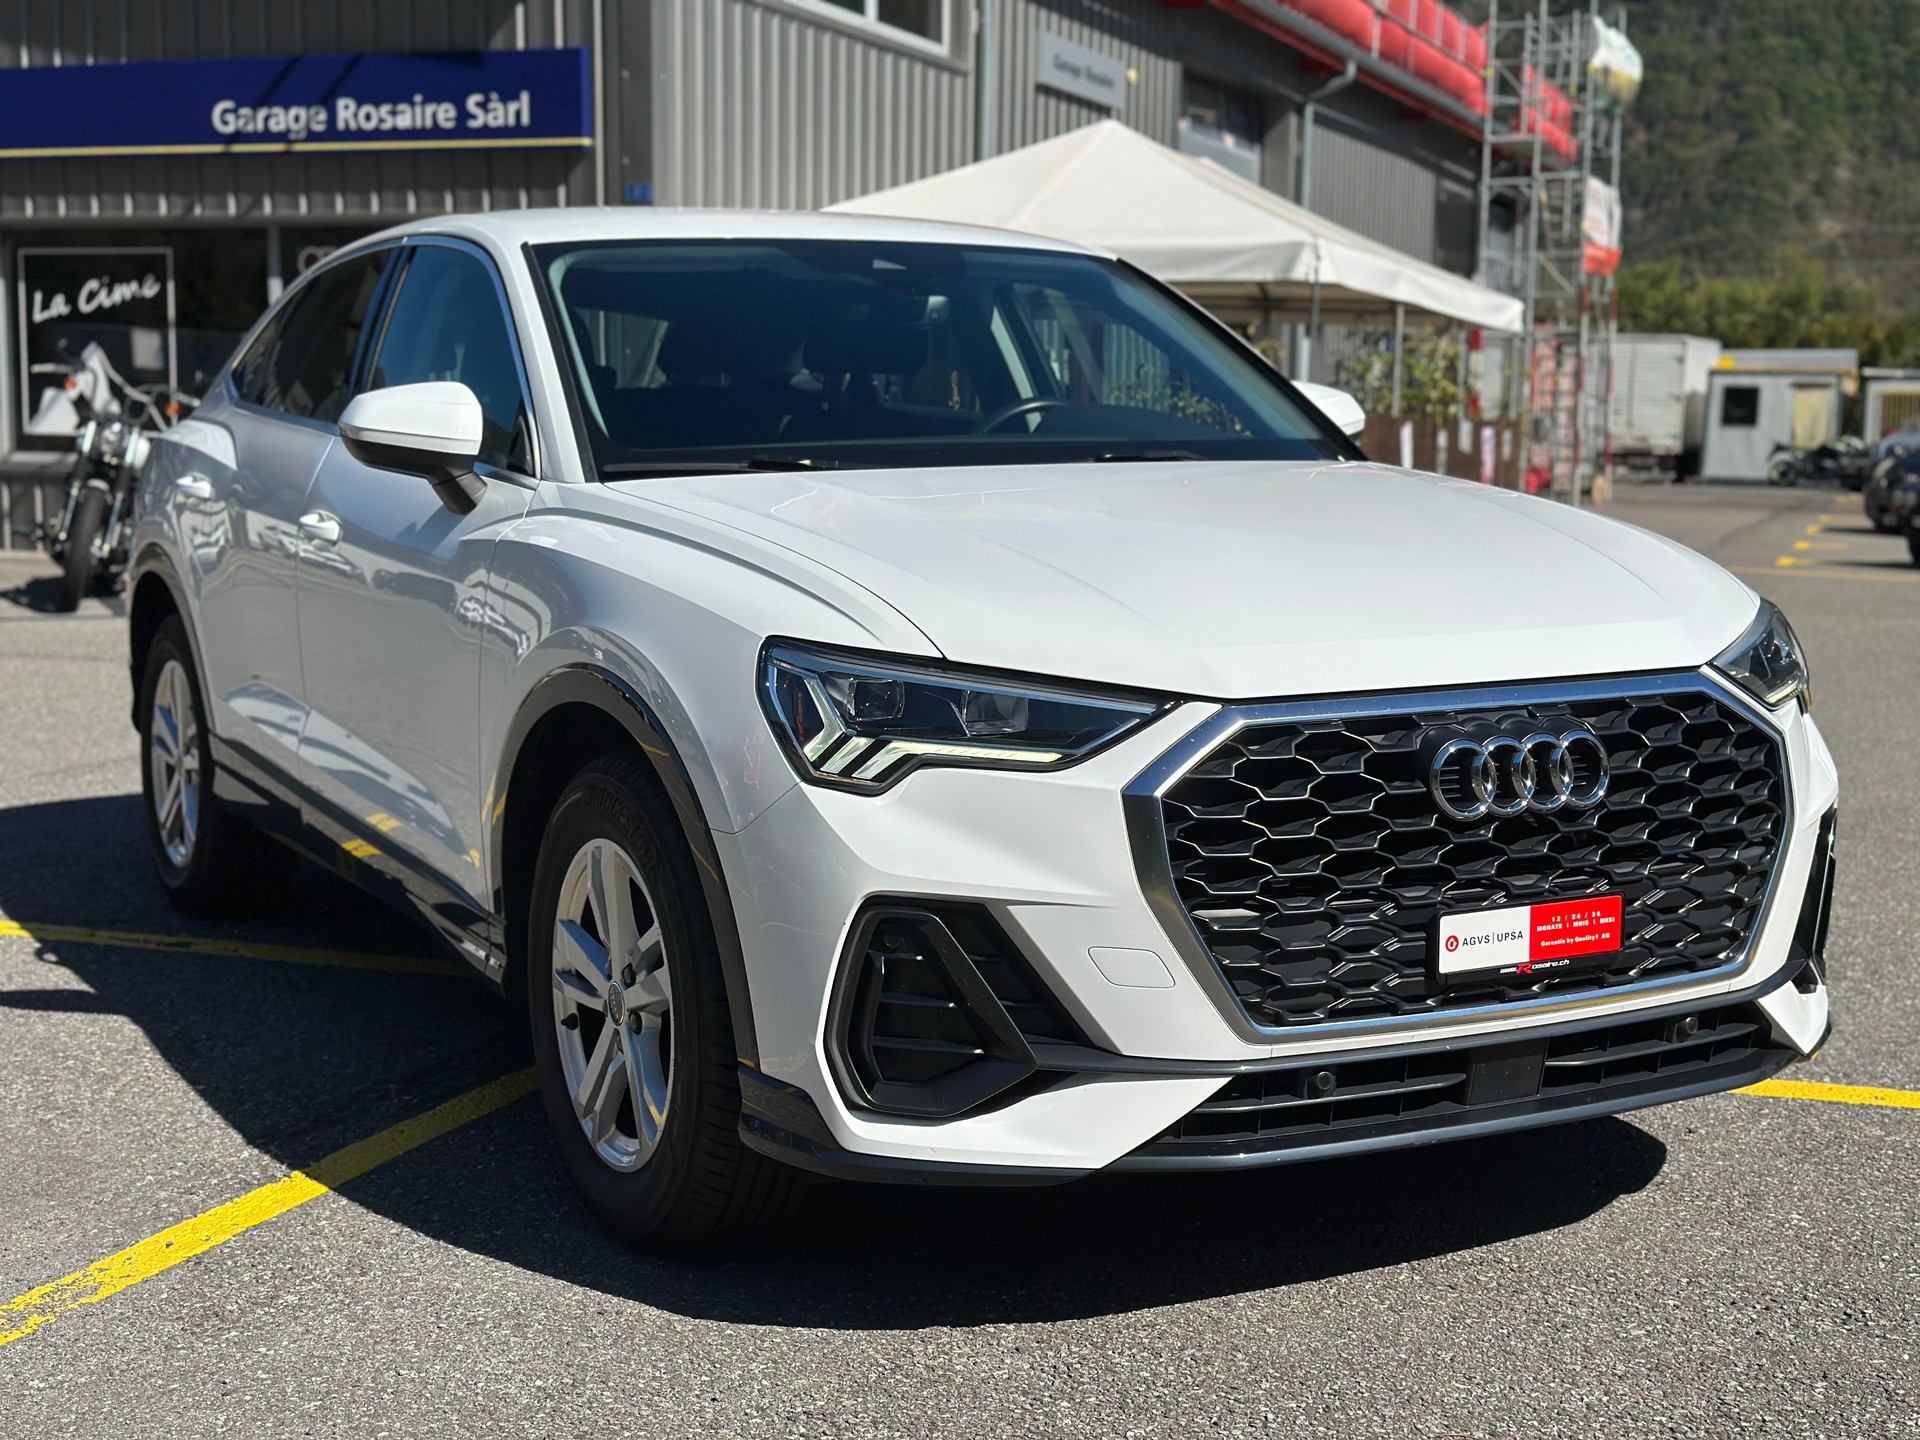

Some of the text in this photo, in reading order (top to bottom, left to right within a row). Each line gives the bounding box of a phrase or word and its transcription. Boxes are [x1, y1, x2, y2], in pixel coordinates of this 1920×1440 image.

[211, 90, 531, 140] Garage Rosaire Sàrl
[32, 273, 161, 324] La Cime
[1462, 930, 1524, 947] AGVS UPSA
[1536, 923, 1563, 932] MONATE
